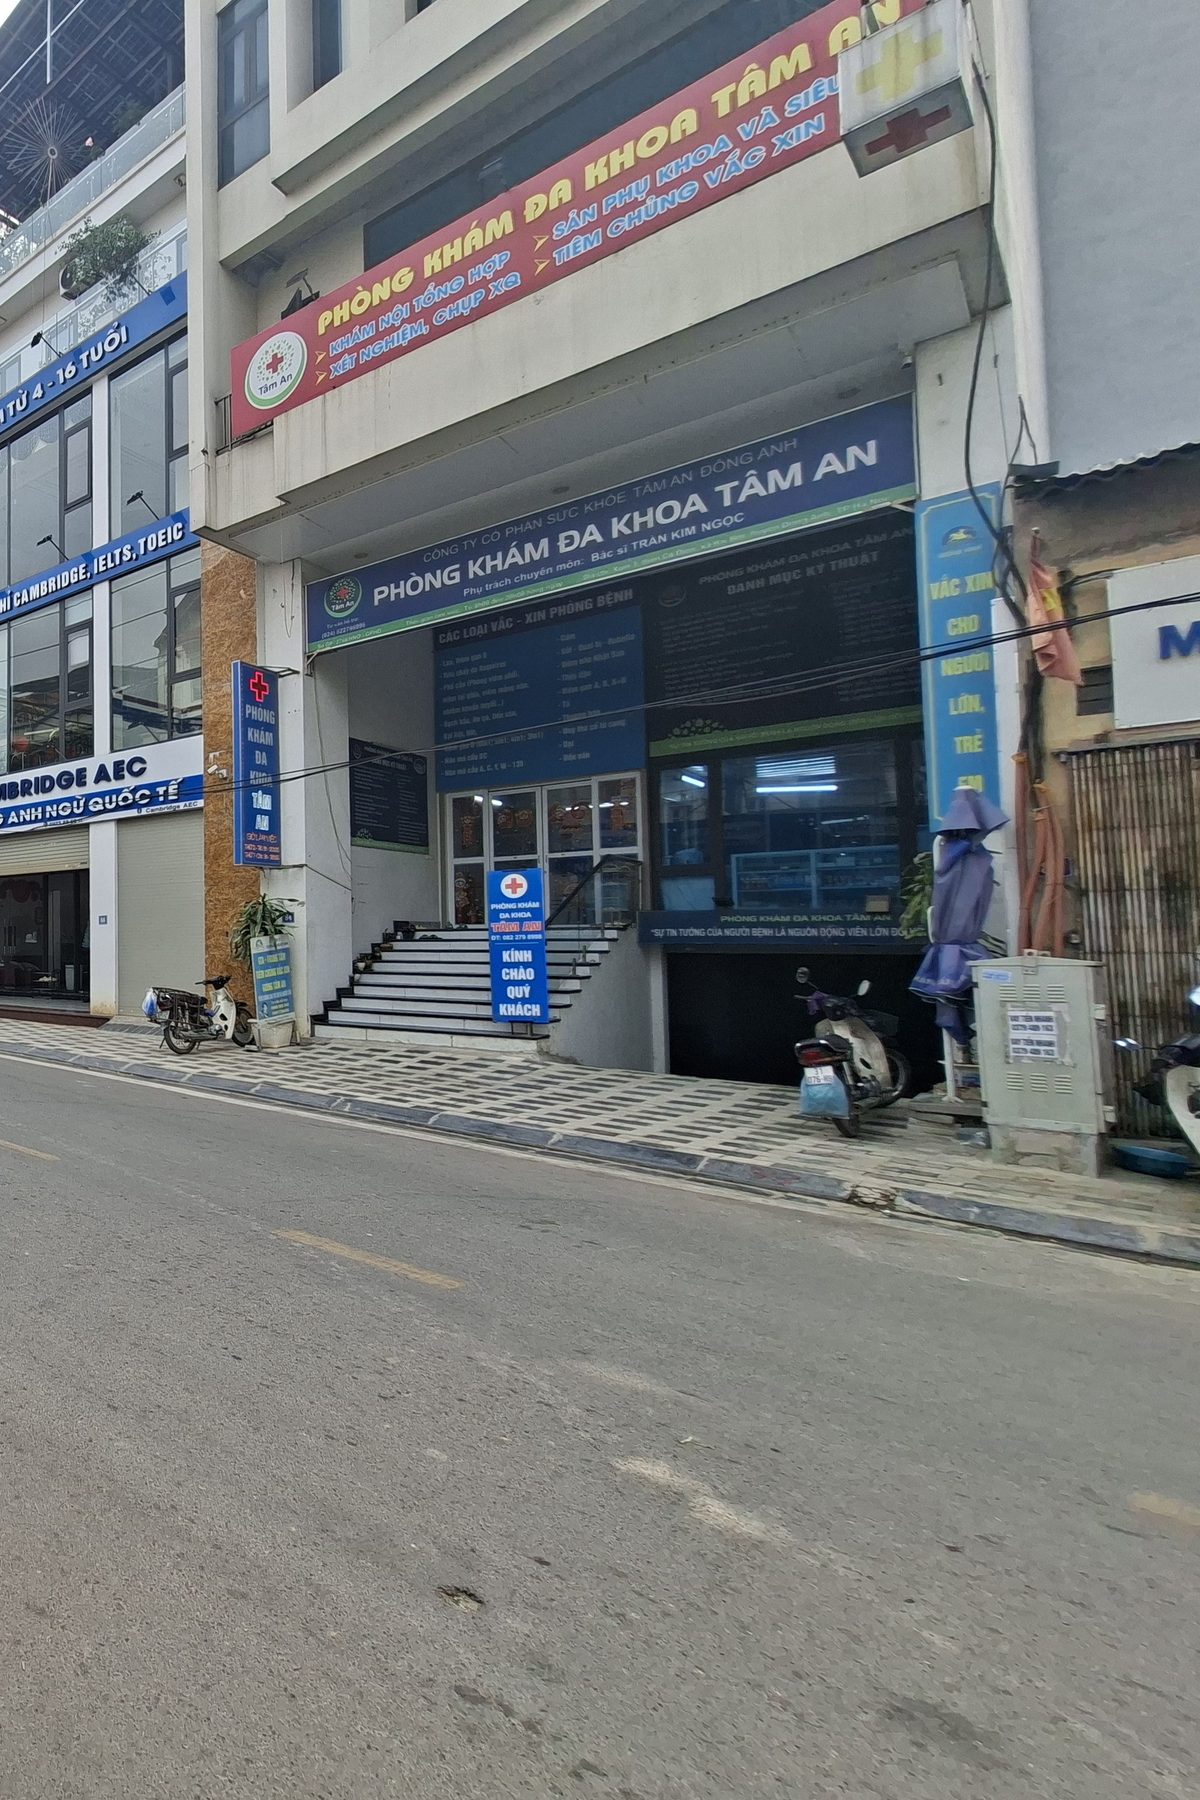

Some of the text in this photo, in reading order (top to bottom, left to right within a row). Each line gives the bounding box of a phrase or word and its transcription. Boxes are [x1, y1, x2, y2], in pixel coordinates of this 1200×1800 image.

[553, 200, 598, 241] SẢN
[602, 174, 651, 216] PHỤ
[656, 133, 732, 188] KHOA
[784, 73, 840, 117] SIÊU
[317, 265, 414, 336] PHÒNG
[423, 215, 514, 279] KHÁM
[523, 178, 572, 224] ĐA
[584, 108, 697, 192] KHOA
[710, 43, 812, 118] TÂM
[553, 228, 602, 267] TIÊM
[704, 148, 766, 190] VẮC
[771, 112, 825, 157] XIN
[329, 251, 511, 356] KHÁM NỘI TỔNG HỢP
[329, 271, 521, 379] XÉT NGHIỆM, CHỤP XQ
[6, 389, 28, 421] TỪ
[32, 382, 45, 400] 4
[56, 363, 76, 385] 16
[78, 323, 128, 369] TUỔI
[258, 373, 293, 397] Tâm An
[373, 563, 461, 607] PHÒNG
[468, 537, 550, 580] KHÁM
[557, 523, 604, 554] ĐA
[611, 493, 709, 539] KHOA
[714, 461, 803, 508] TÂM
[811, 439, 878, 482] AN
[13, 562, 91, 609] CAMBRIDGE,
[93, 541, 138, 576] IELTS,
[138, 521, 185, 555] TOEIC
[463, 586, 483, 598] Phụ
[484, 578, 512, 593] trách
[671, 526, 697, 540] KIM
[701, 511, 745, 535] NGỌC
[463, 622, 488, 640] LOẠI
[525, 610, 546, 625] XIN
[596, 588, 634, 608] BỆNH
[245, 704, 276, 725] PHÒNG
[247, 727, 274, 747] KHÁM
[94, 756, 147, 784] AEC
[255, 750, 268, 766] ĐA
[7, 807, 42, 824] ANH
[88, 786, 151, 812] QUỐC
[155, 778, 184, 801] TẾ
[251, 789, 272, 811] TÂM
[255, 815, 270, 831] AN
[501, 966, 535, 981] CHÀO
[502, 948, 533, 963] KÍNH
[499, 1002, 541, 1017] KHÁCH
[506, 983, 531, 999] QUÝ
